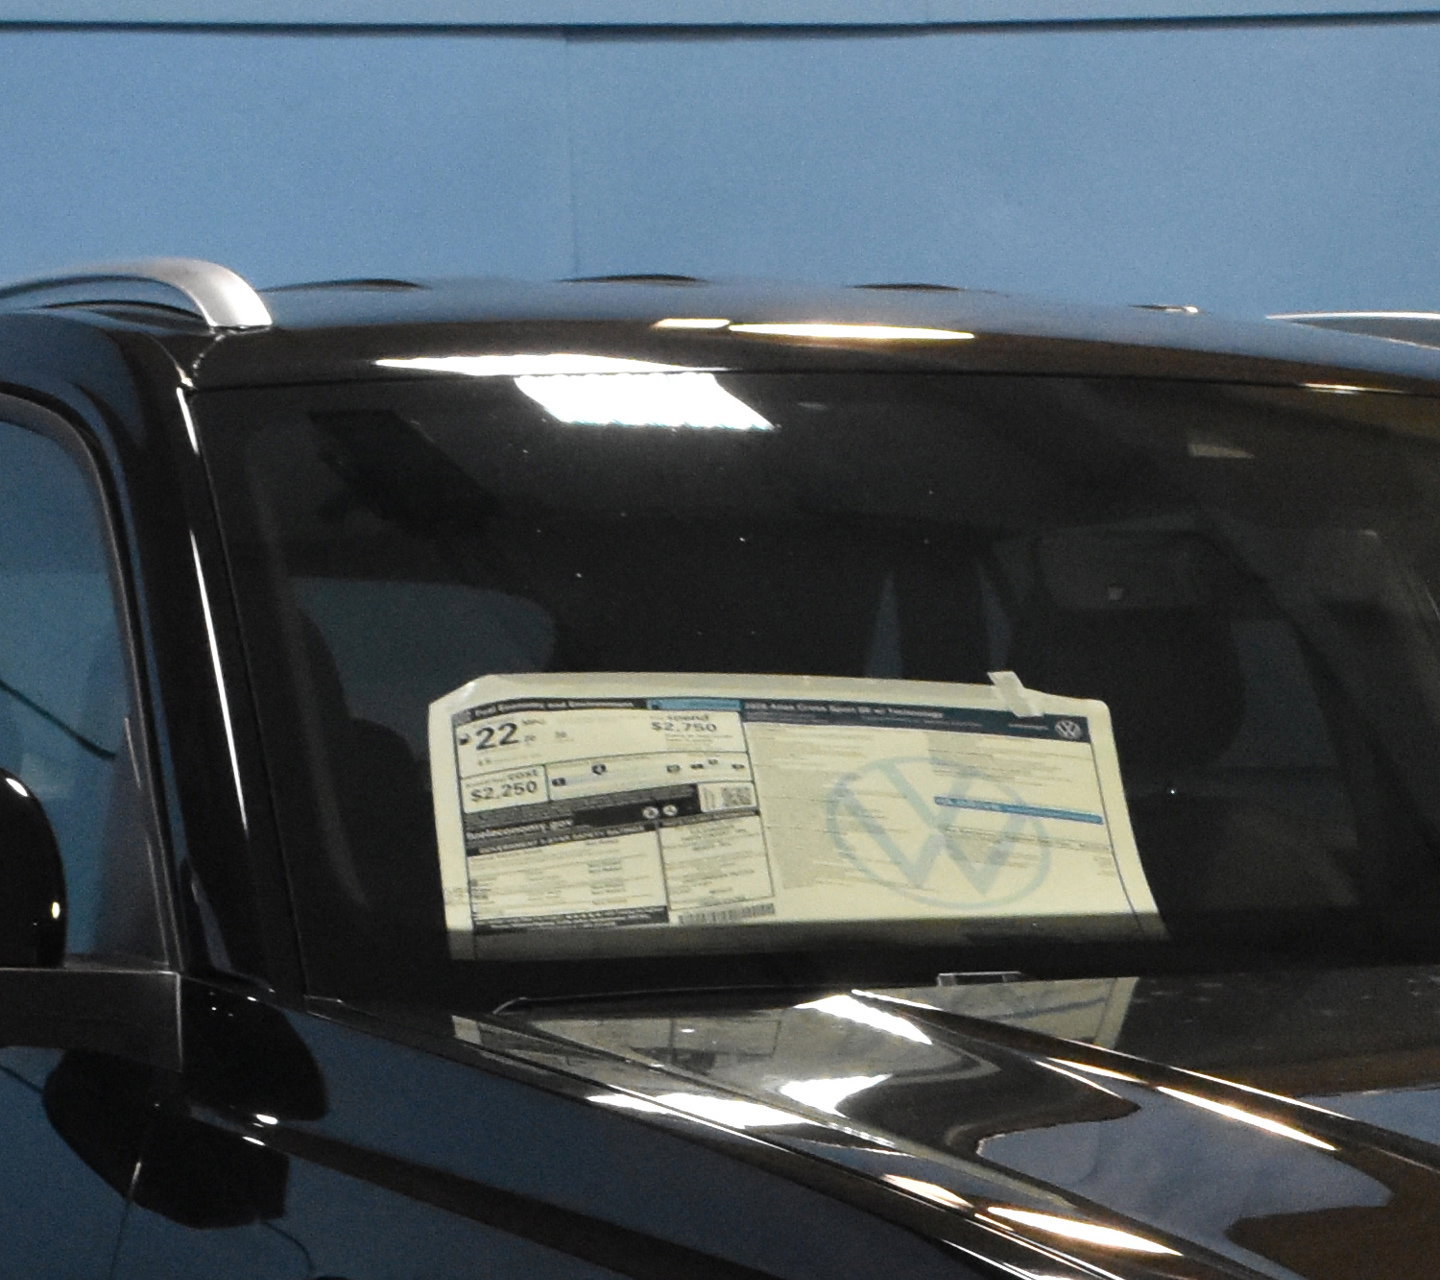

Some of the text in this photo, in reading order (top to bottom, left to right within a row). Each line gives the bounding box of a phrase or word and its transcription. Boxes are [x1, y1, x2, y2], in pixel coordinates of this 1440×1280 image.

[475, 722, 519, 750] 22
[651, 721, 717, 733] $2,750
[470, 780, 538, 802] $2,250
